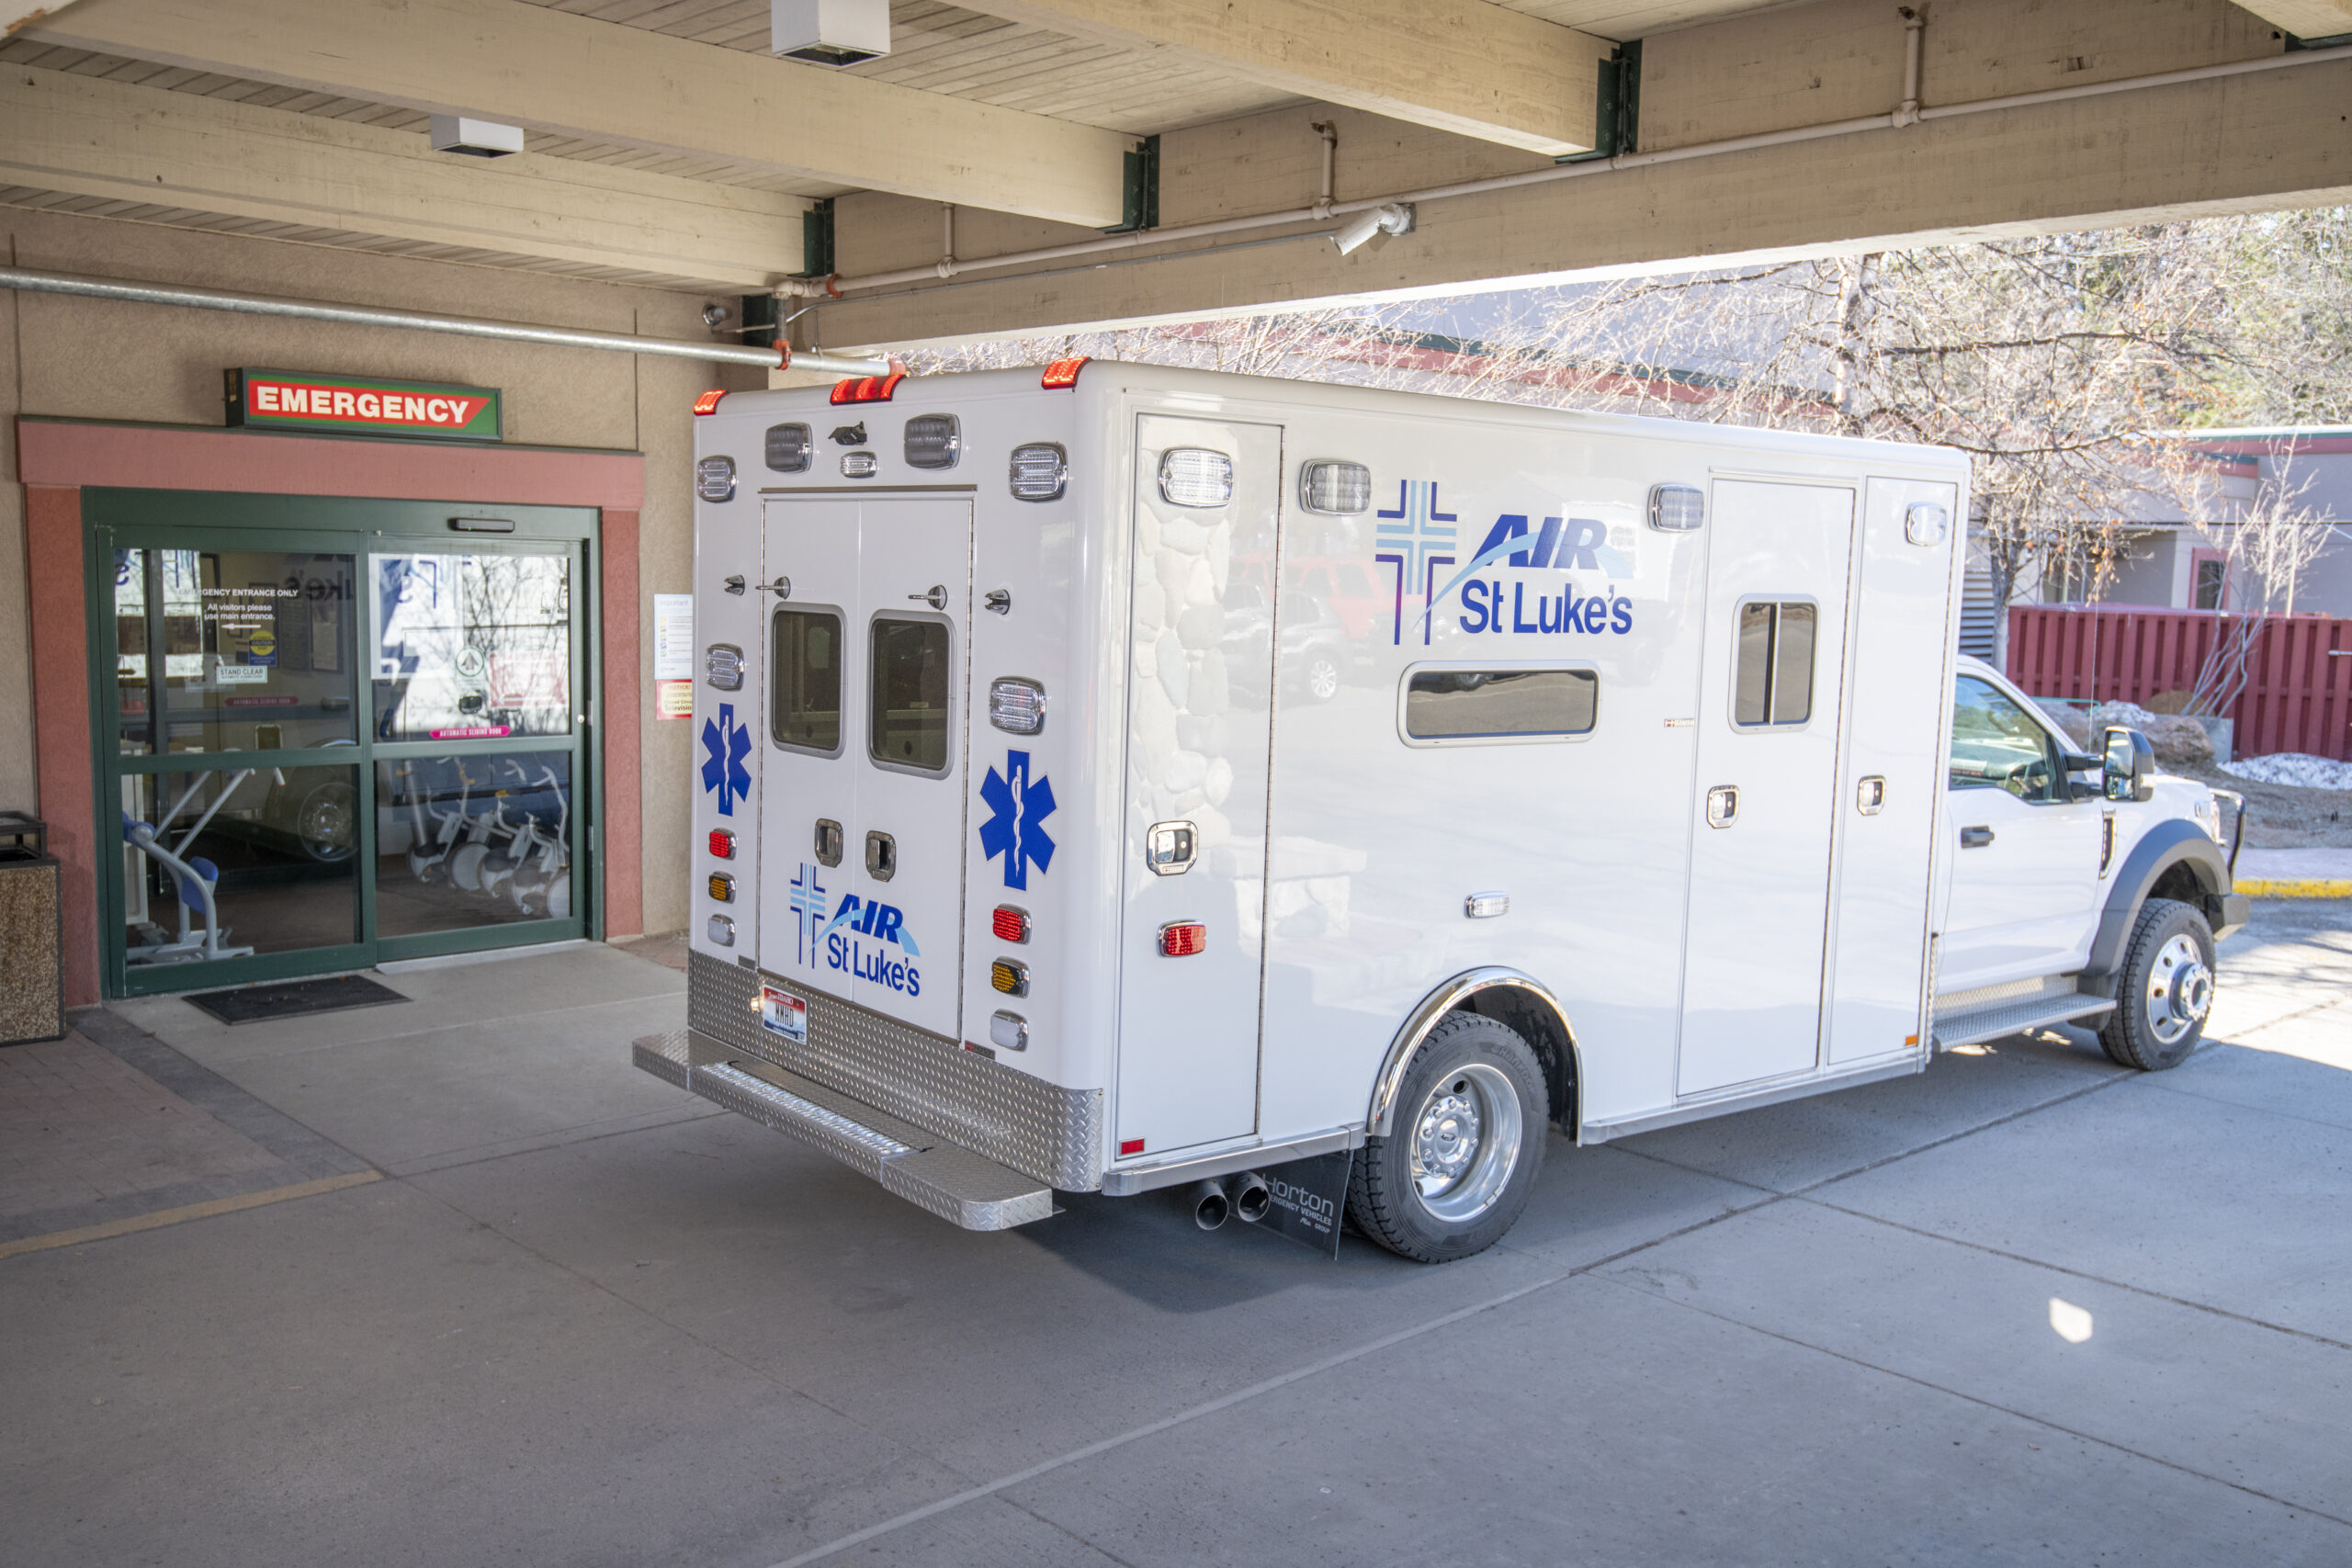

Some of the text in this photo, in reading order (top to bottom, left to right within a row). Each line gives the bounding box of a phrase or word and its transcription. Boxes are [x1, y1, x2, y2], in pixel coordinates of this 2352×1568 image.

[256, 386, 469, 423] EMERGENCY
[1470, 513, 1608, 570] AIR
[207, 603, 273, 614] All visitors please
[232, 588, 276, 597] ENTRANCE
[277, 589, 299, 597] ONLY
[1459, 579, 1634, 635] St Luke's
[203, 613, 276, 621] use main entrance.
[220, 668, 242, 676] STAND
[439, 728, 468, 737] AUTOMATIC
[831, 893, 904, 944] AIR
[826, 932, 921, 998] St Luke's
[1261, 1172, 1334, 1218] Horton
[1269, 1193, 1332, 1226] ERGENCY VEHICLES
